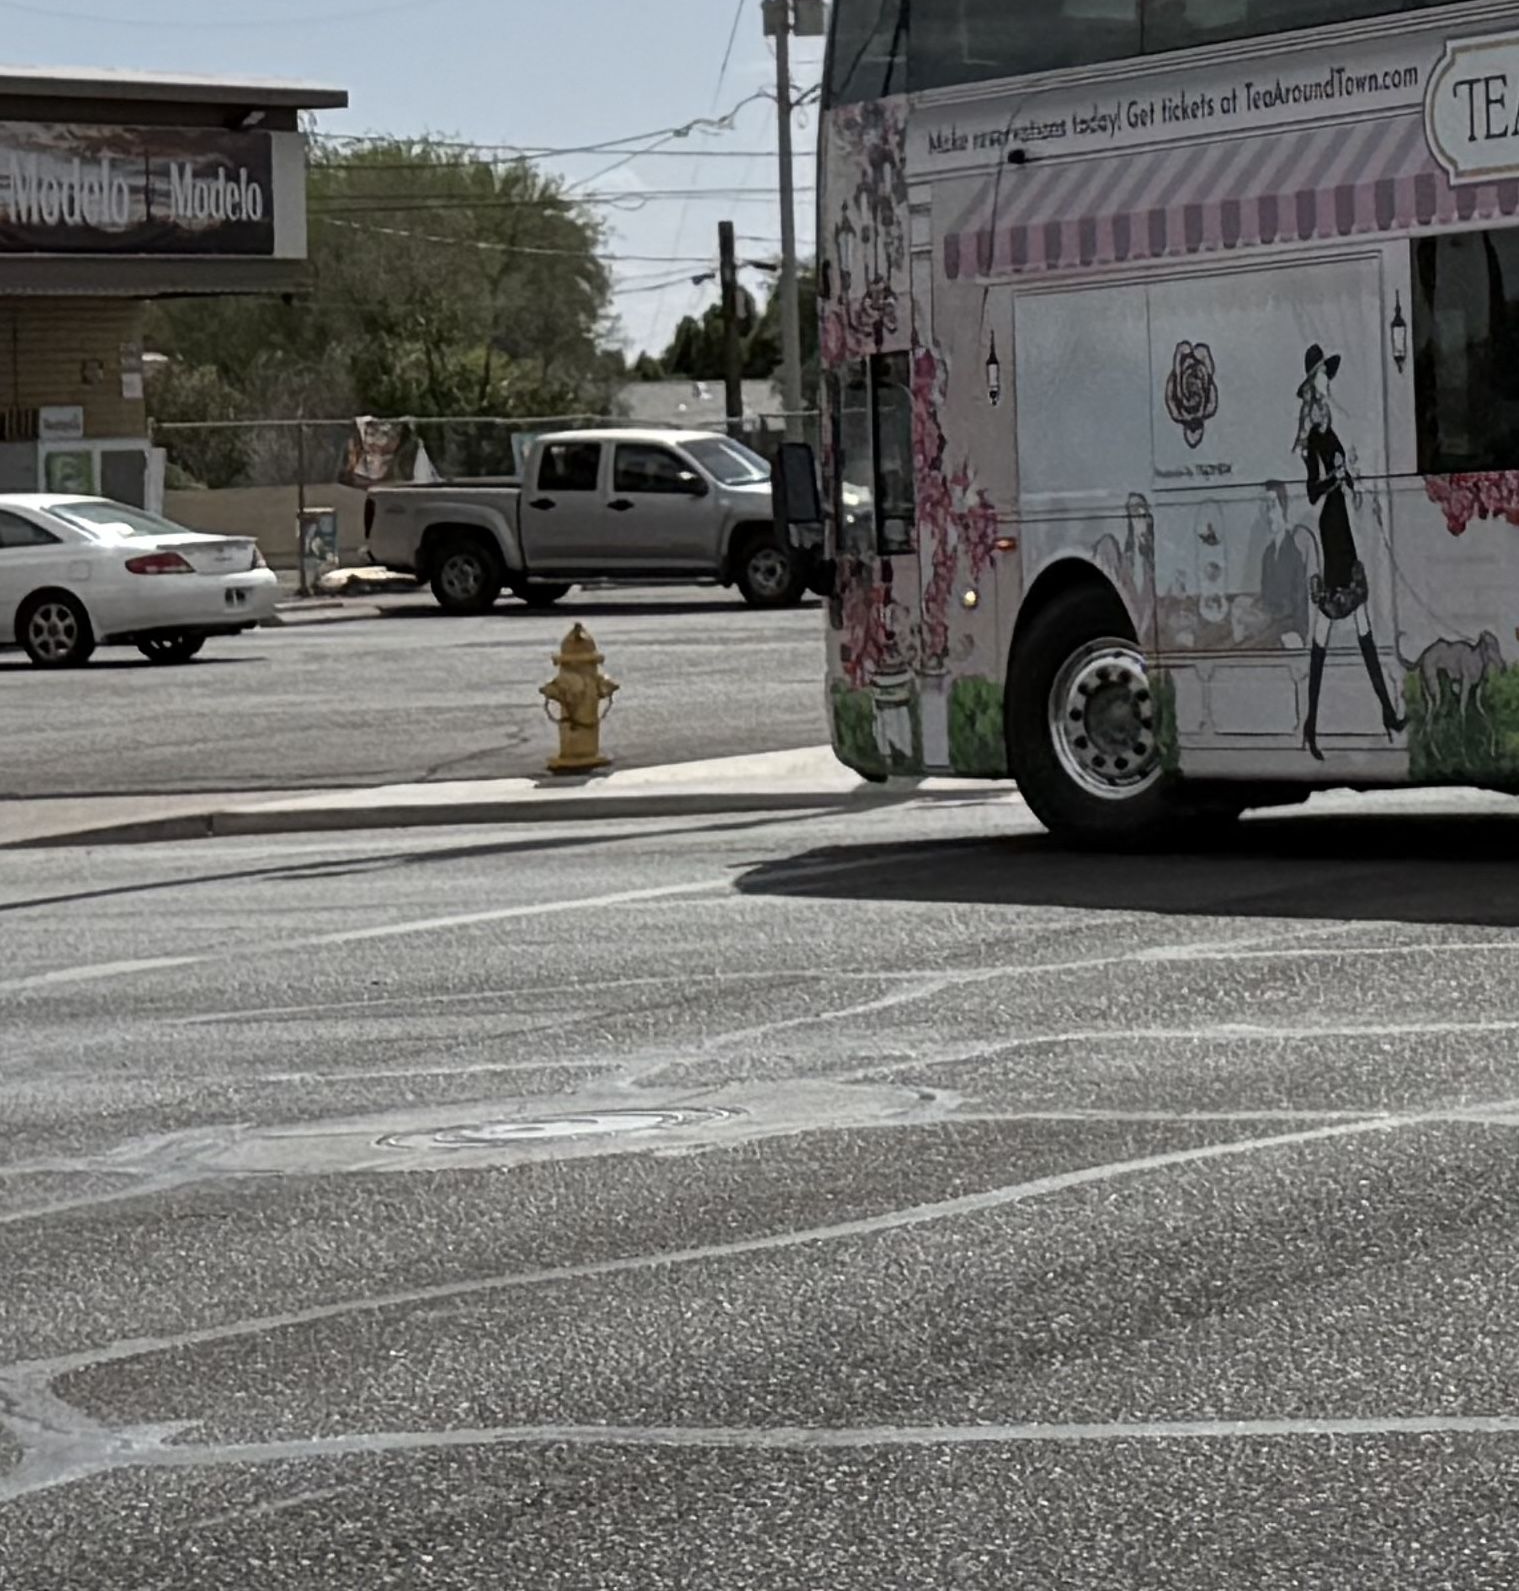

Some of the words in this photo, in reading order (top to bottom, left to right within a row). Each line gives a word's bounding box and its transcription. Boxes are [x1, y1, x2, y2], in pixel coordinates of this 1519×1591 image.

[1072, 102, 1122, 139] today!
[1127, 100, 1155, 129] Get
[1161, 88, 1214, 124] tickets
[1220, 87, 1237, 114] at
[1244, 65, 1419, 112] TeaAroundTown.com
[8, 152, 130, 226] Modelo
[169, 161, 263, 221] Modelo
